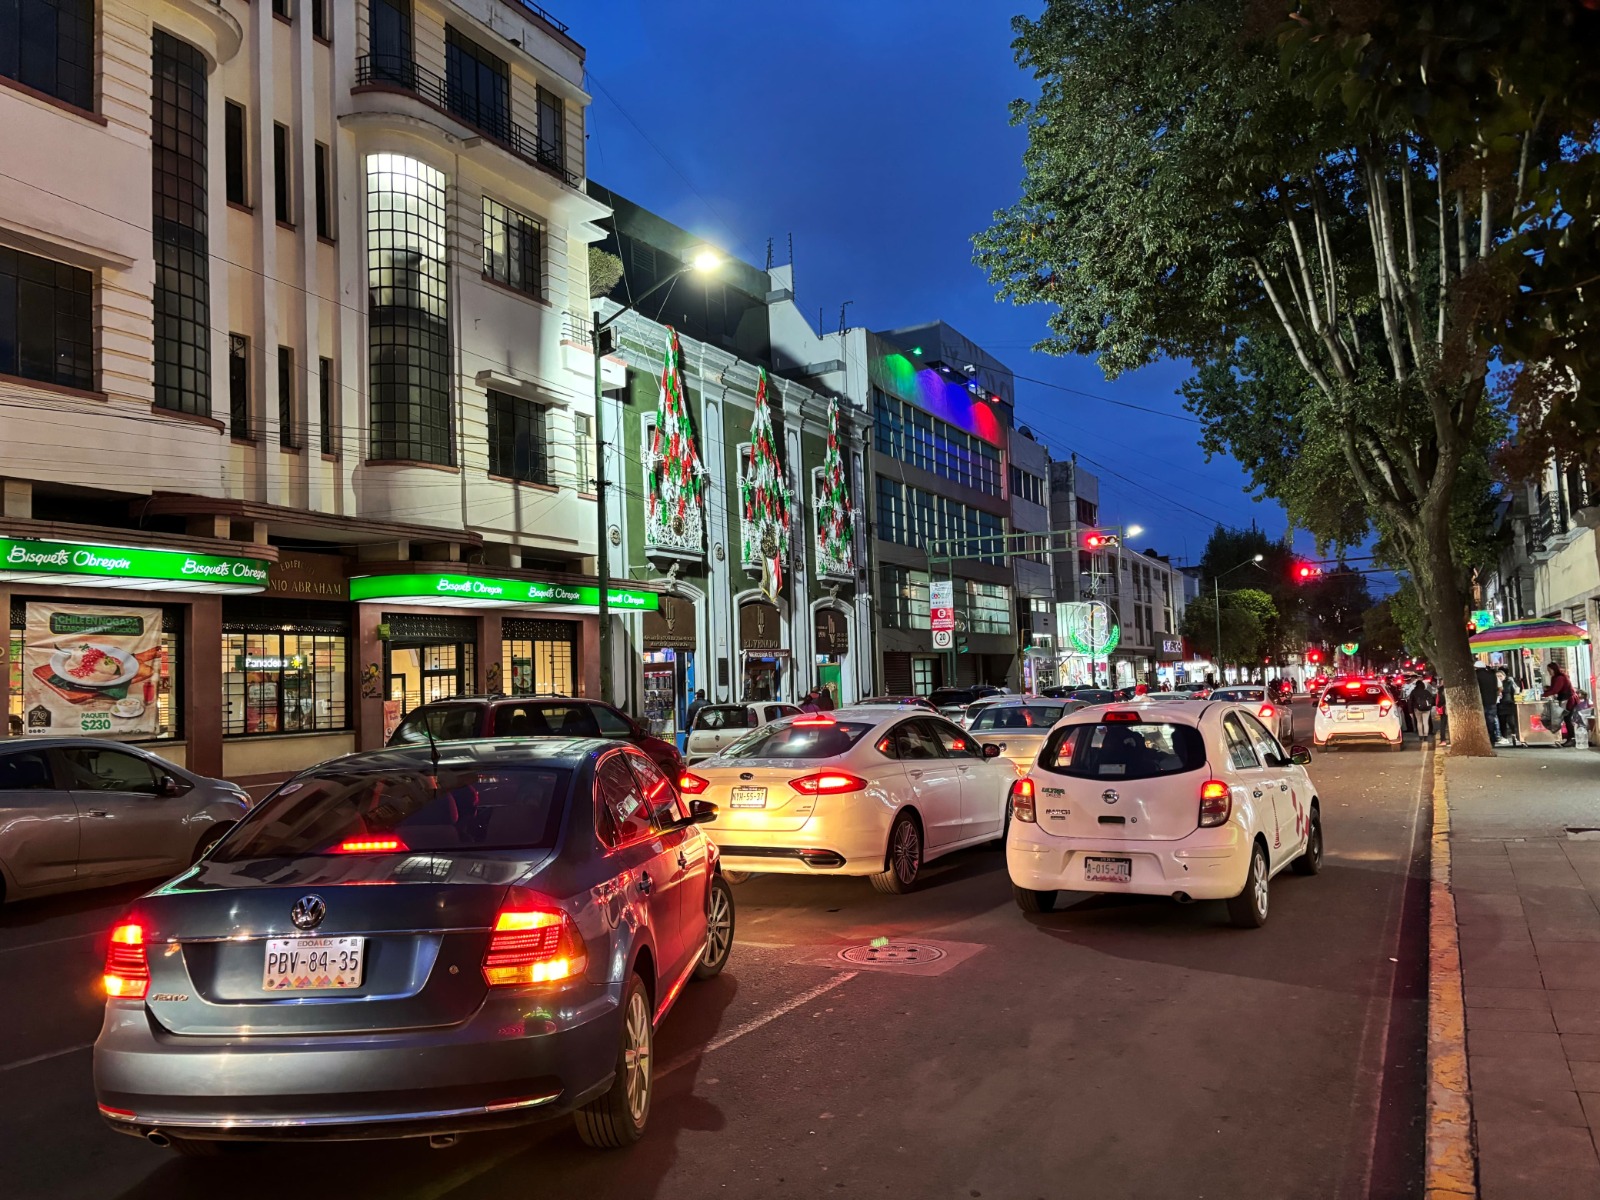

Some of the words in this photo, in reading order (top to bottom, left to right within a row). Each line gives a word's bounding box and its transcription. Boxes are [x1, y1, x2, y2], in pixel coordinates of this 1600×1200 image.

[7, 545, 71, 565] Bisquets
[73, 550, 131, 570] Obregón
[181, 558, 231, 576] Bisquets
[291, 580, 342, 595] ABRAHAM
[437, 578, 471, 592] Bisquets
[528, 586, 555, 598] Bisquets
[85, 616, 98, 625] EN
[98, 616, 139, 627] NOGADA
[939, 633, 946, 641] 20
[1175, 662, 1183, 672] E
[81, 719, 112, 731] $230
[267, 950, 360, 975] PBV-84-35
